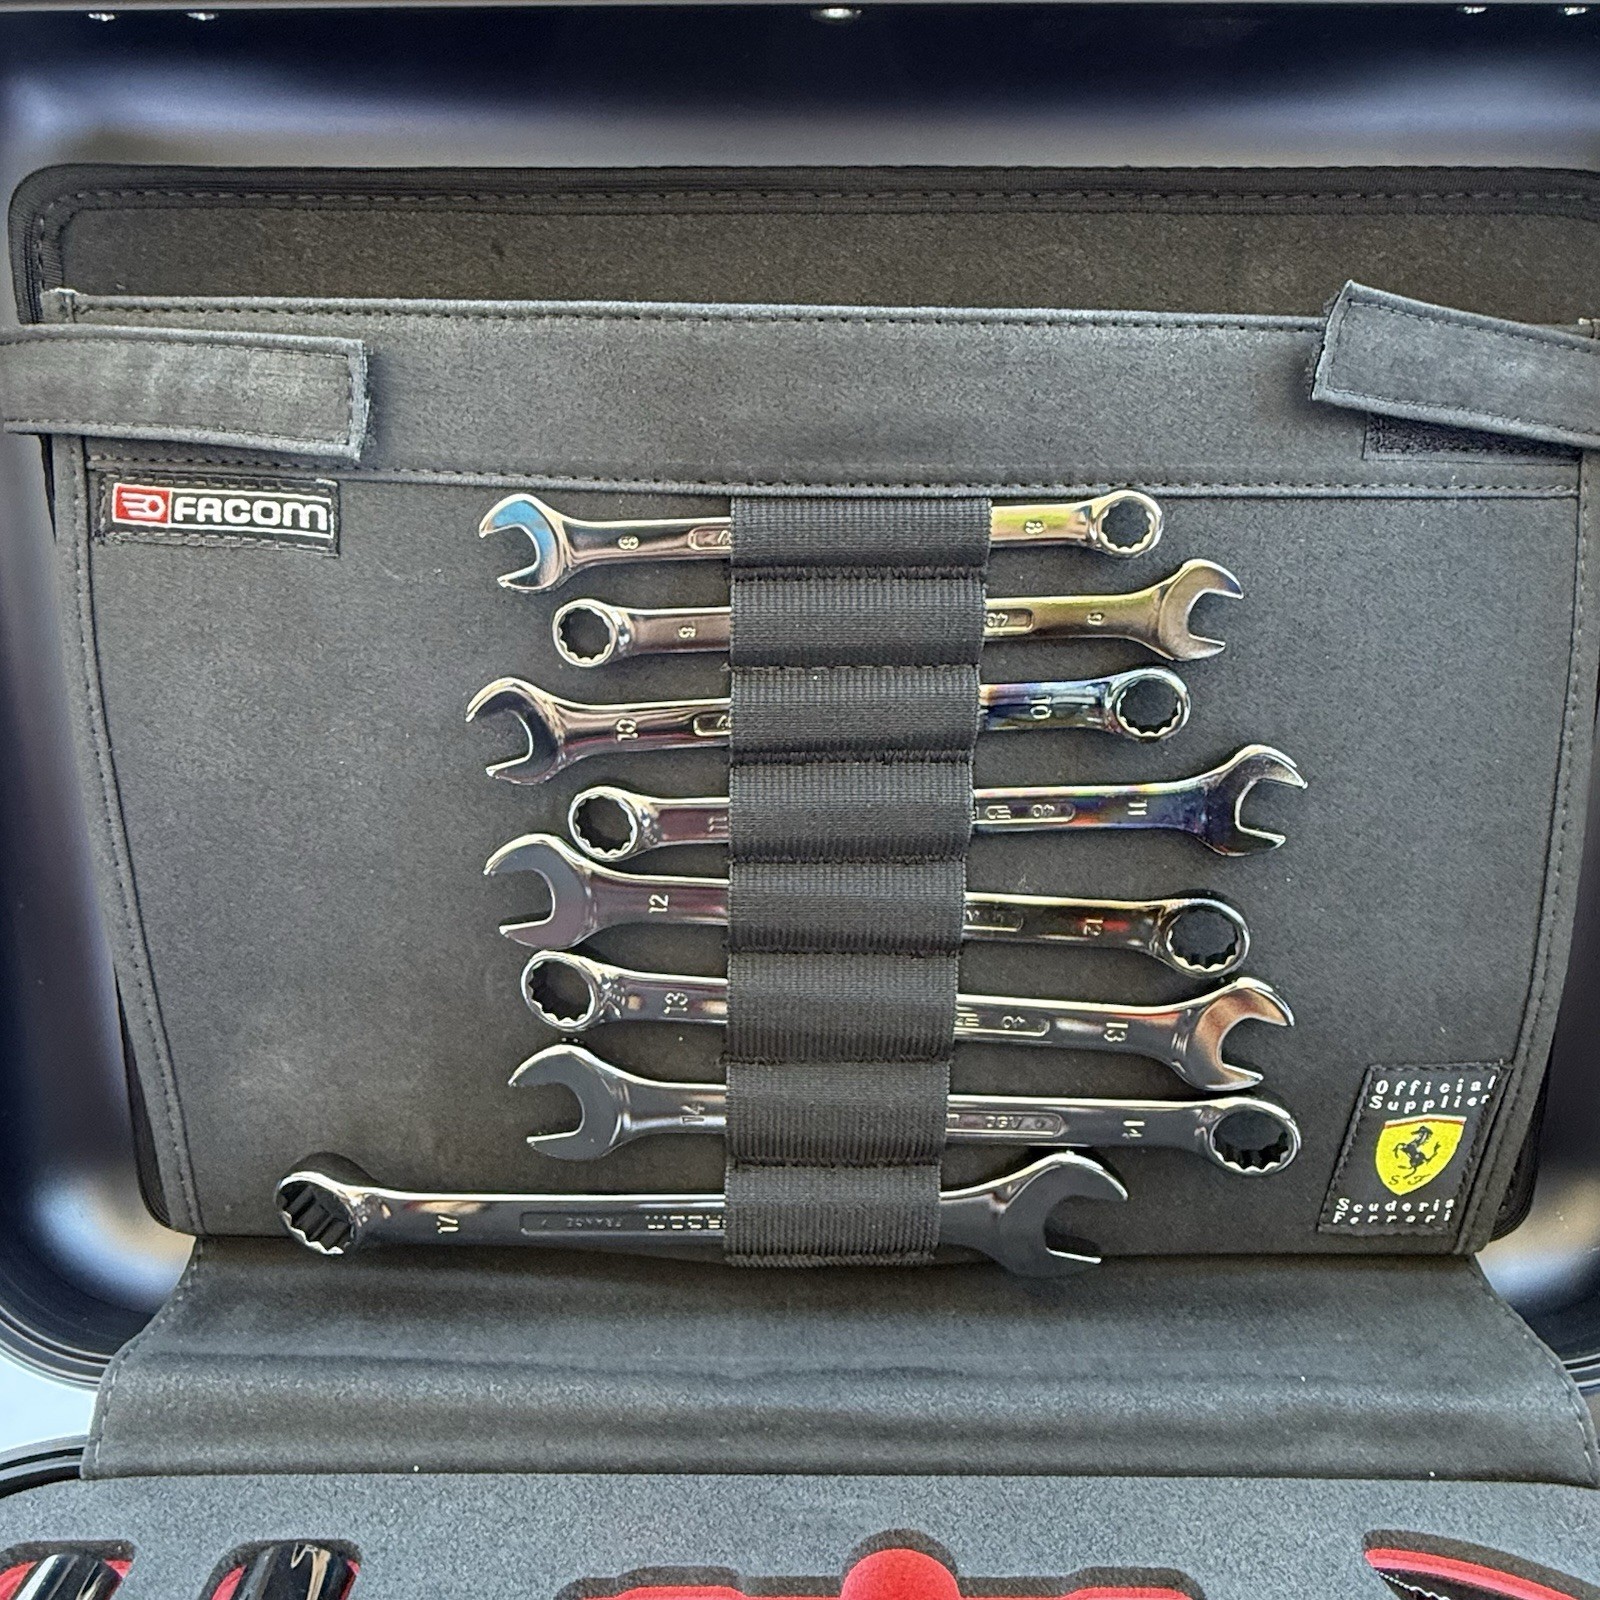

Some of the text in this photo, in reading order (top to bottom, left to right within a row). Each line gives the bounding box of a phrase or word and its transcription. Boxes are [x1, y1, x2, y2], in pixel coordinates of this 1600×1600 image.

[173, 496, 328, 531] FACOM
[1024, 520, 1045, 535] 8
[618, 535, 639, 550] 8
[678, 625, 696, 639] 9
[1030, 695, 1052, 720] 10
[616, 718, 639, 742] 10
[1127, 800, 1148, 816] 11
[648, 894, 669, 914] 12
[1082, 918, 1104, 937] 12
[663, 992, 689, 1015] 13
[1103, 1021, 1129, 1043] 13
[1375, 1075, 1496, 1096] Official
[1368, 1094, 1490, 1114] Supplier
[1336, 1198, 1455, 1213] Scuderia
[436, 1214, 459, 1234] 17
[645, 1214, 727, 1230] ACOM
[1332, 1210, 1452, 1224] Ferrari
